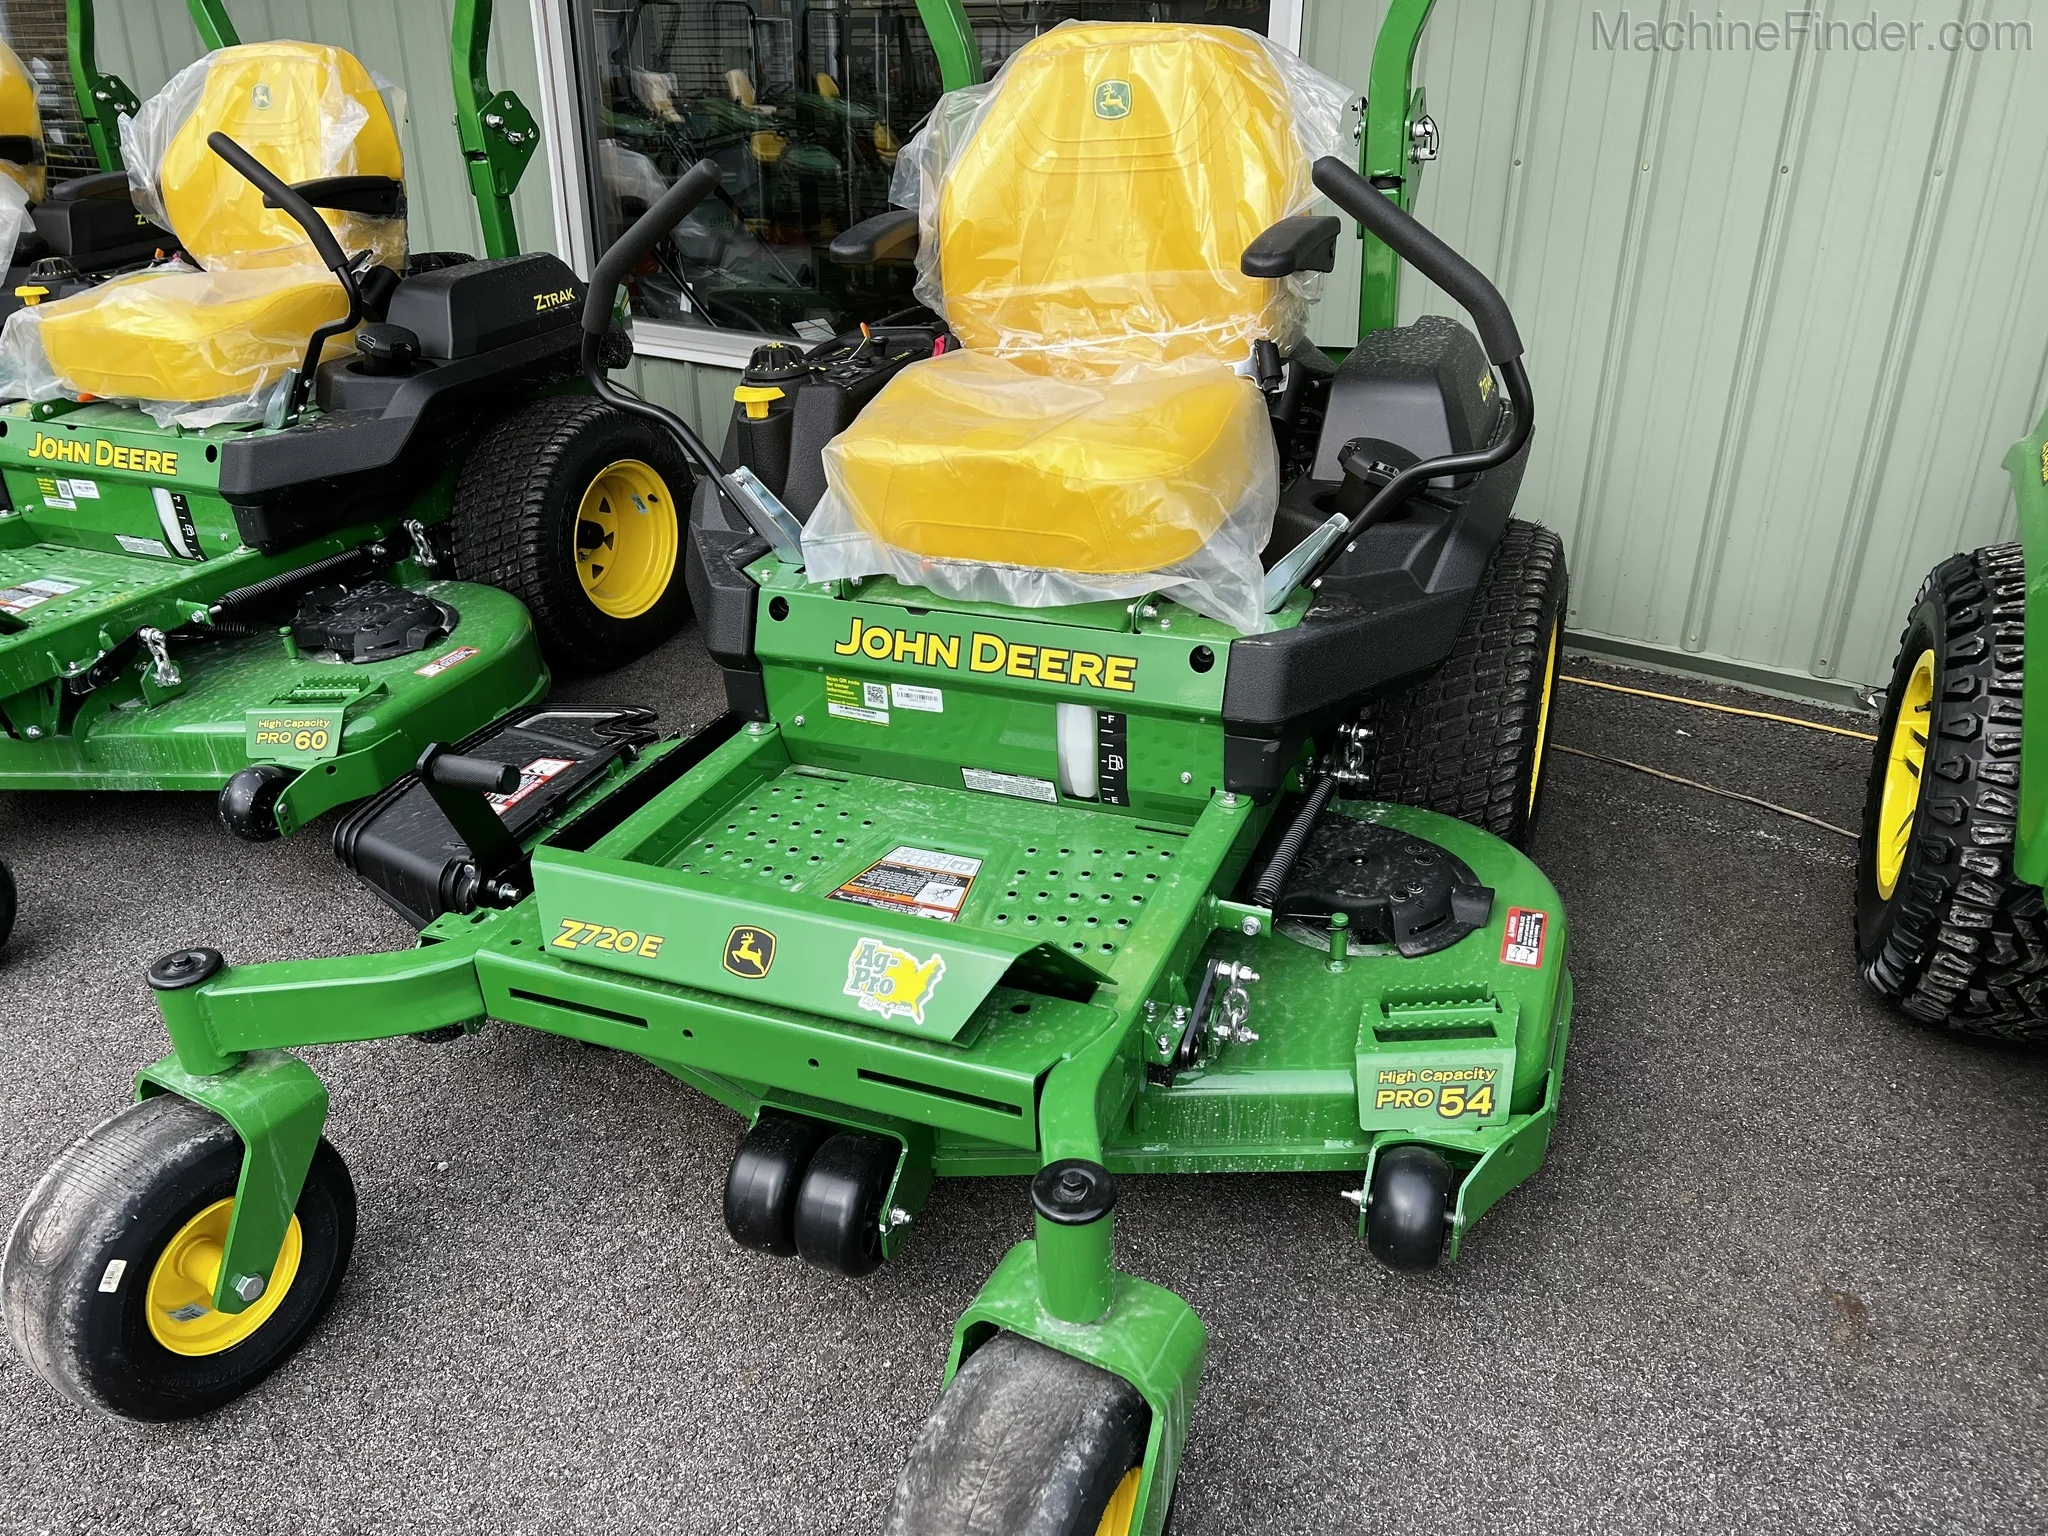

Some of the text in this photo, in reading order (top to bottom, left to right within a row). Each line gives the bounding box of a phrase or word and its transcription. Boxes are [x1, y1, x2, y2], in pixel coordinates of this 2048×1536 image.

[533, 287, 576, 311] ZTRAK
[28, 431, 178, 476] JOHN DEERE
[835, 617, 1139, 693] JOHN DEERE
[258, 718, 331, 730] High Capacity
[1108, 714, 1115, 724] F
[256, 729, 329, 751] PRO 60
[1111, 796, 1119, 804] E
[848, 967, 896, 995] Pro
[861, 995, 912, 1013] AgProCo.com
[1378, 1067, 1498, 1086] High Capacity
[1375, 1084, 1496, 1119] PRO 54
